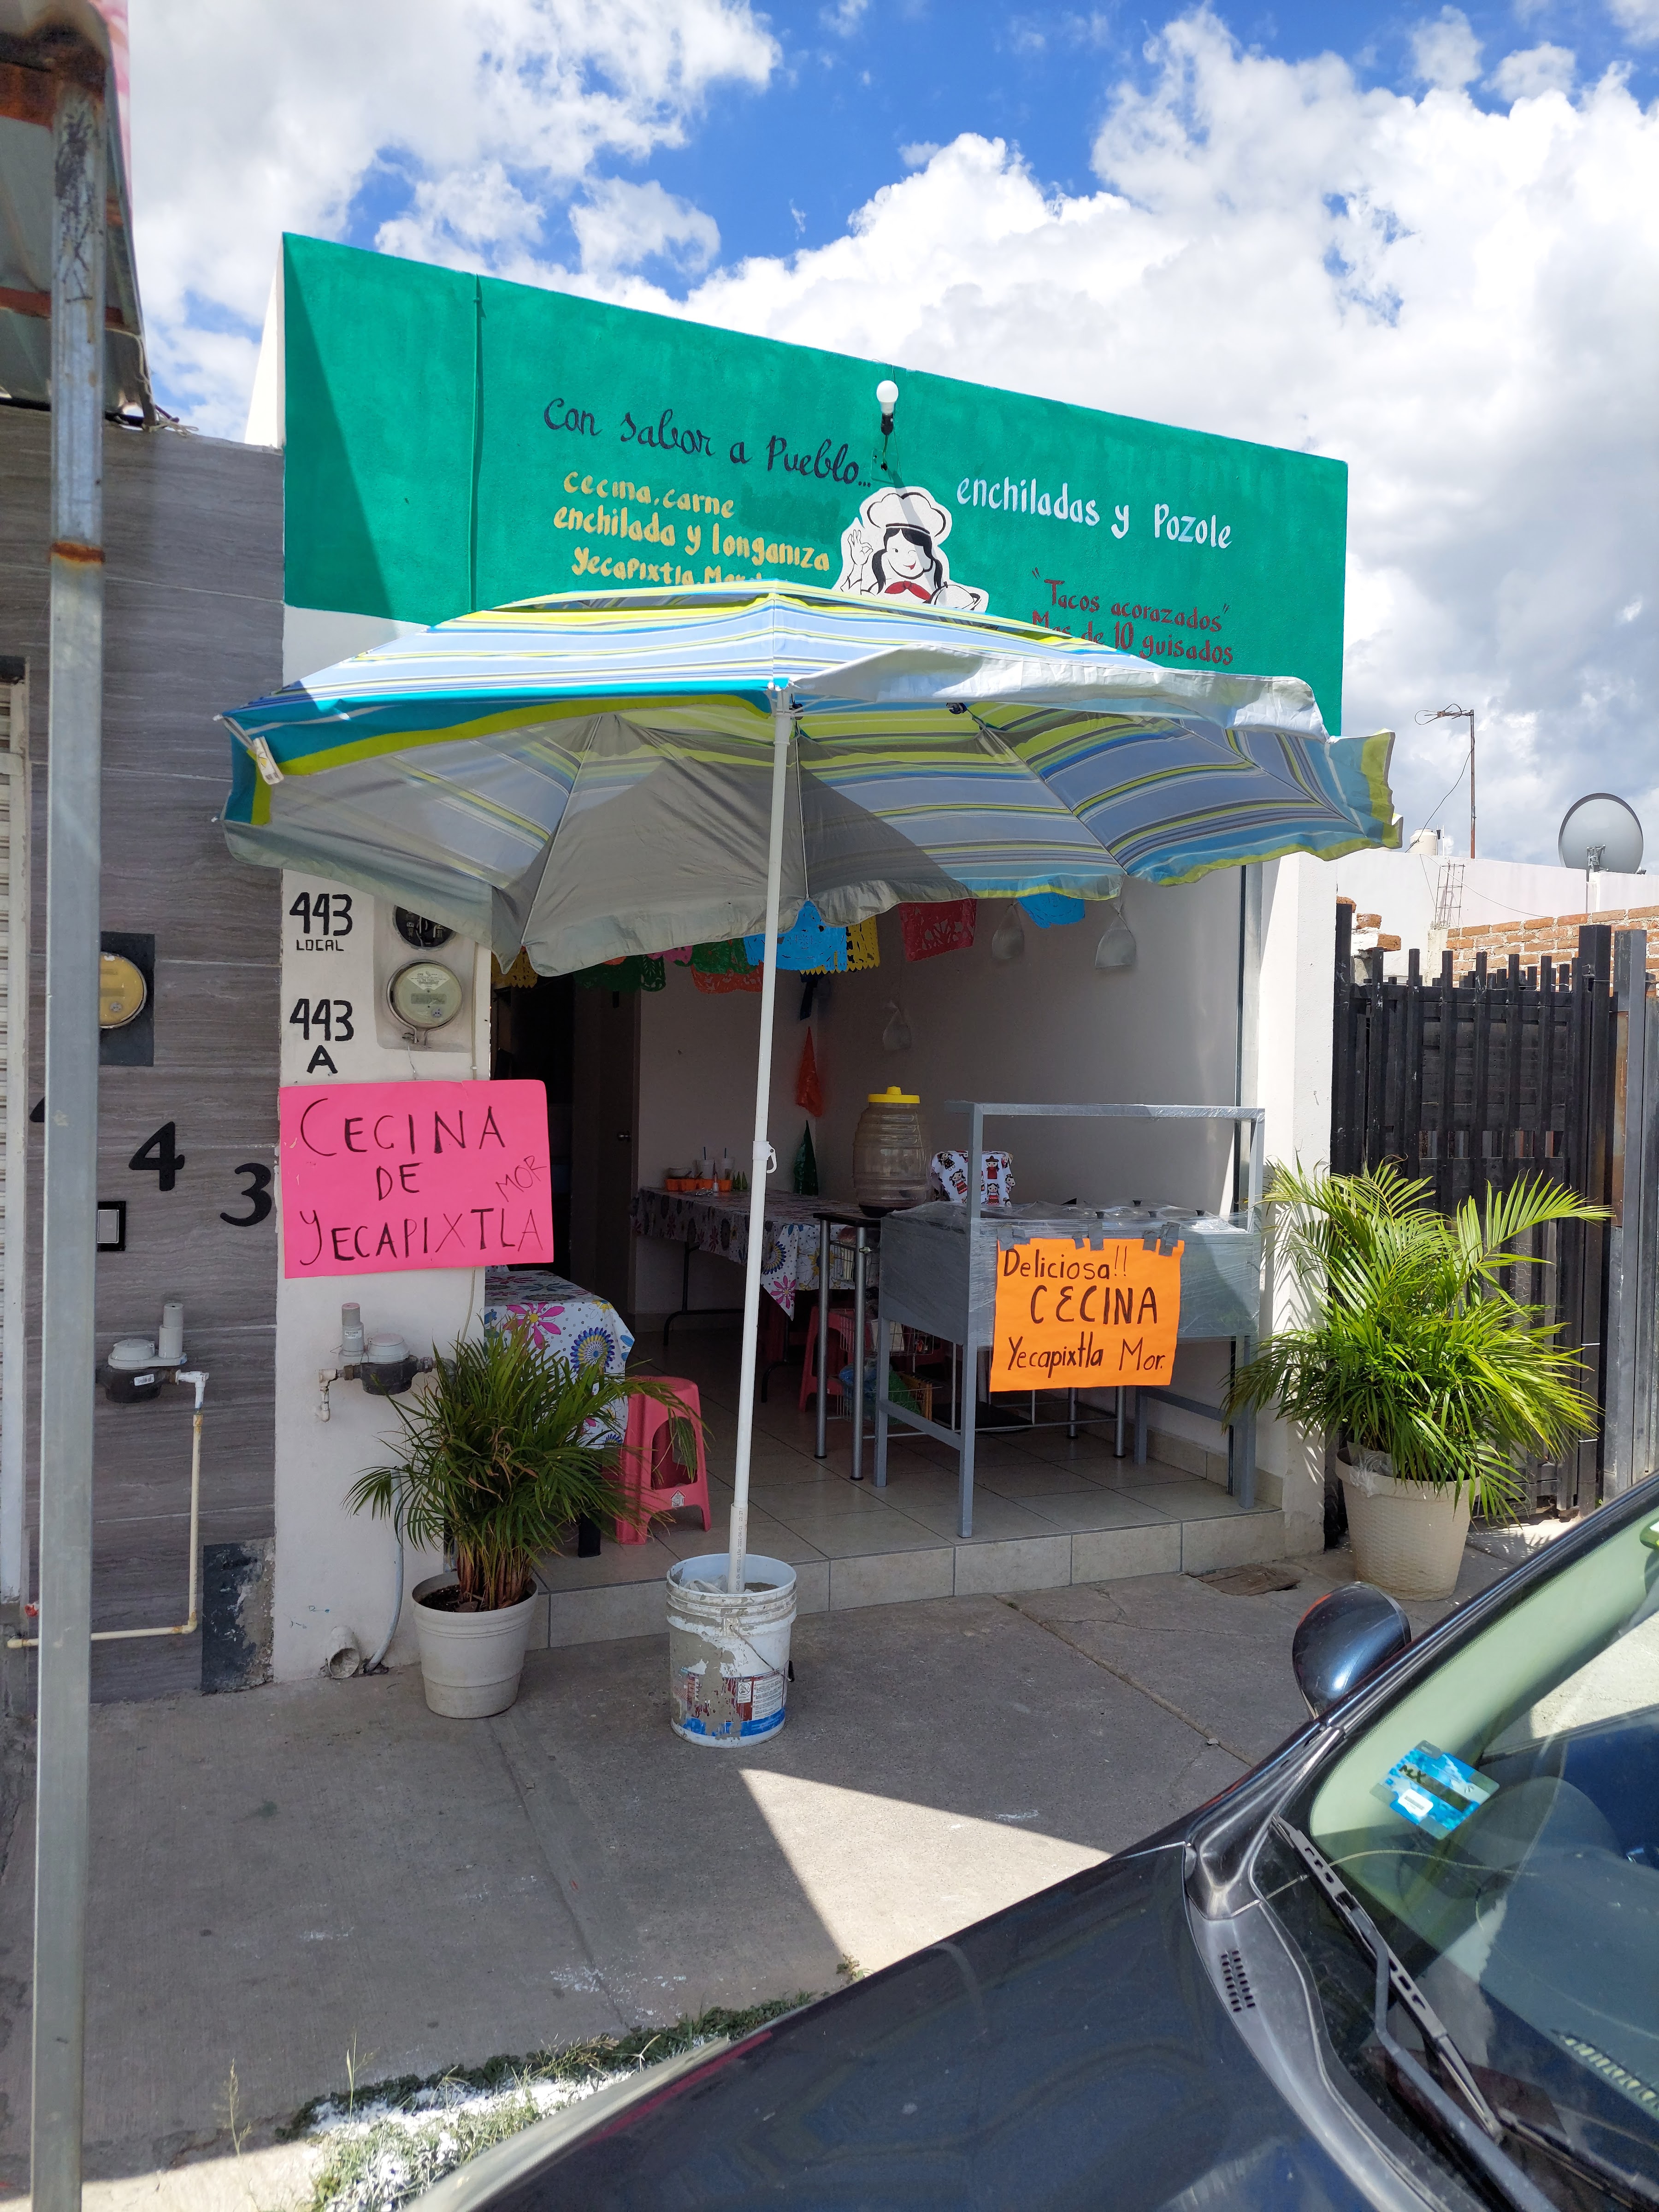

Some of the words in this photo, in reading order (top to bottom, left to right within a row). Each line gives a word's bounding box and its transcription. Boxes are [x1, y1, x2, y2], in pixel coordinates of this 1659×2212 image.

[544, 397, 603, 437] Con
[620, 408, 716, 457] sabor
[729, 441, 753, 465] a
[662, 489, 735, 519] carne
[956, 477, 1101, 527] enchiladas
[1110, 504, 1130, 539] y
[1154, 503, 1233, 549] Pozole
[554, 504, 676, 547] enchilada
[685, 524, 702, 556] y
[712, 523, 830, 572] longaniza
[1080, 620, 1104, 645] de
[1114, 621, 1134, 650] 10
[1139, 634, 1234, 666] guisados
[289, 891, 353, 937] 443
[296, 939, 345, 952] LOCAL
[289, 998, 354, 1042] 443
[306, 1044, 338, 1074] A
[300, 1097, 506, 1157] CECINA
[375, 1162, 424, 1201] DE
[495, 1154, 548, 1203] MOR
[1003, 1245, 1128, 1280] Deliciosa!!
[1030, 1284, 1157, 1325] CECINA
[1008, 1331, 1104, 1379] Yecapixtla
[1118, 1336, 1167, 1371] Mor.
